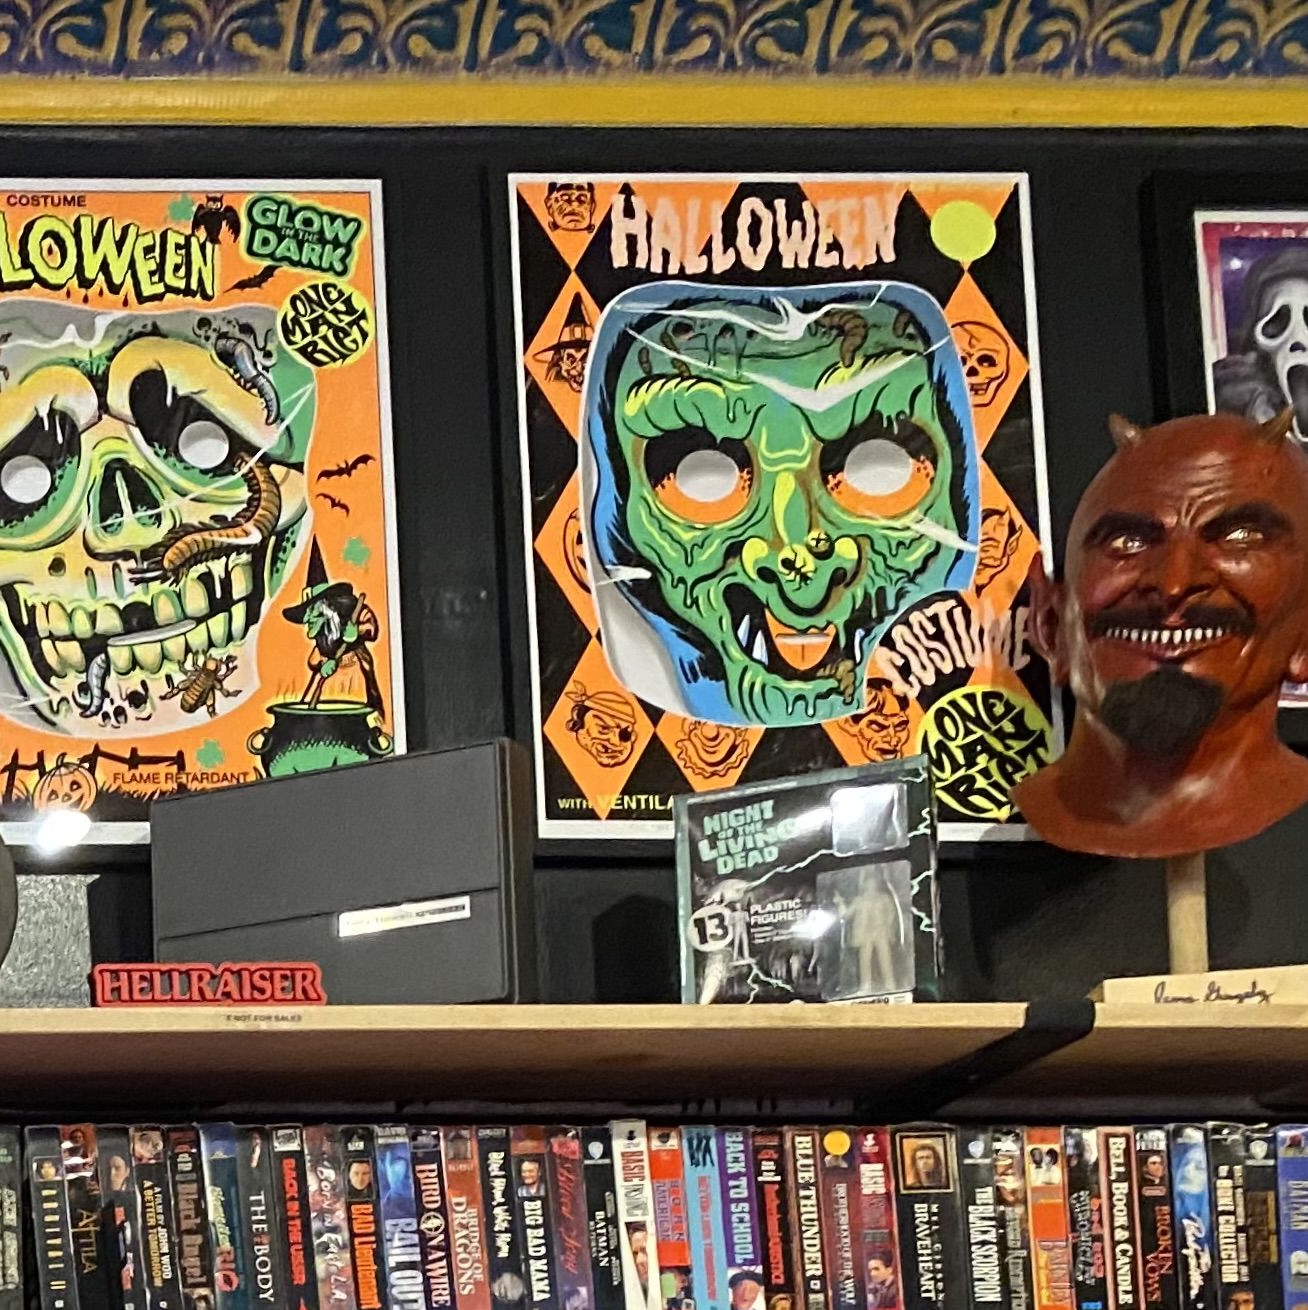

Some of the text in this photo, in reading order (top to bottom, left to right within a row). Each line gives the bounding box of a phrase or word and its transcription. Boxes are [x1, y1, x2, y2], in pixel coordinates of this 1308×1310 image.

[6, 195, 87, 207] COSTUME
[252, 199, 358, 243] GLOW
[253, 229, 346, 272] DARK
[298, 231, 319, 242] THE
[611, 193, 899, 275] HALLOWEEN
[875, 599, 1030, 697] COSTUME
[113, 772, 248, 785] FLAME RETARDANT
[559, 796, 675, 809] WITH VENTILA
[703, 799, 774, 836] NIGHT
[698, 817, 799, 862] LIVING
[717, 846, 779, 875] DEAD
[750, 898, 801, 914] PLASTIC
[693, 912, 729, 945] 13
[102, 968, 320, 1002] HELLRAISER
[725, 1131, 753, 1263] BACK TO SCHOOL
[794, 1135, 821, 1276] BLUE THUNDER
[1112, 1183, 1129, 1225] BOOK
[386, 1218, 419, 1267] BAIL
[968, 1205, 998, 1242] BLACK
[249, 1191, 274, 1301] THE BODY
[525, 1201, 550, 1301] BIG BAD MAMA
[914, 1204, 936, 1301] BRAVEHEART
[972, 1245, 1001, 1301] SCORPION
[1115, 1243, 1134, 1304] CANDLE
